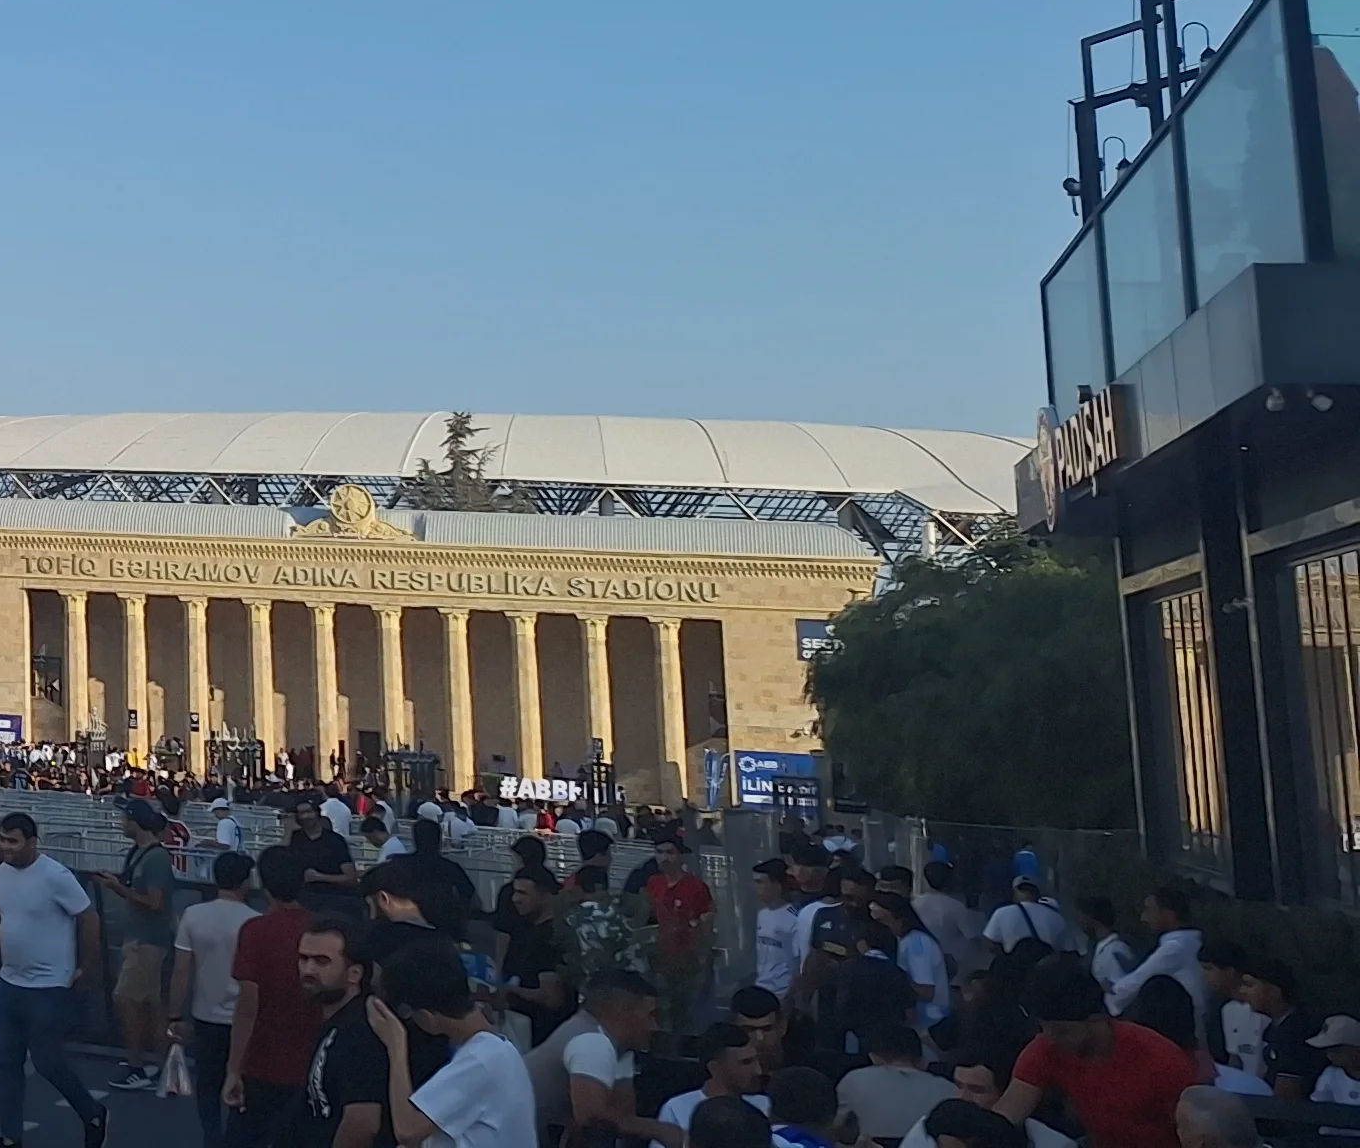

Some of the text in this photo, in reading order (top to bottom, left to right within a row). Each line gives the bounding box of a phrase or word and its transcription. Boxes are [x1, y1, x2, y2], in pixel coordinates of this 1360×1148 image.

[20, 554, 720, 602] TOFİQ BƏHRAMOV ADINA RESPUBLİKA STADİONU
